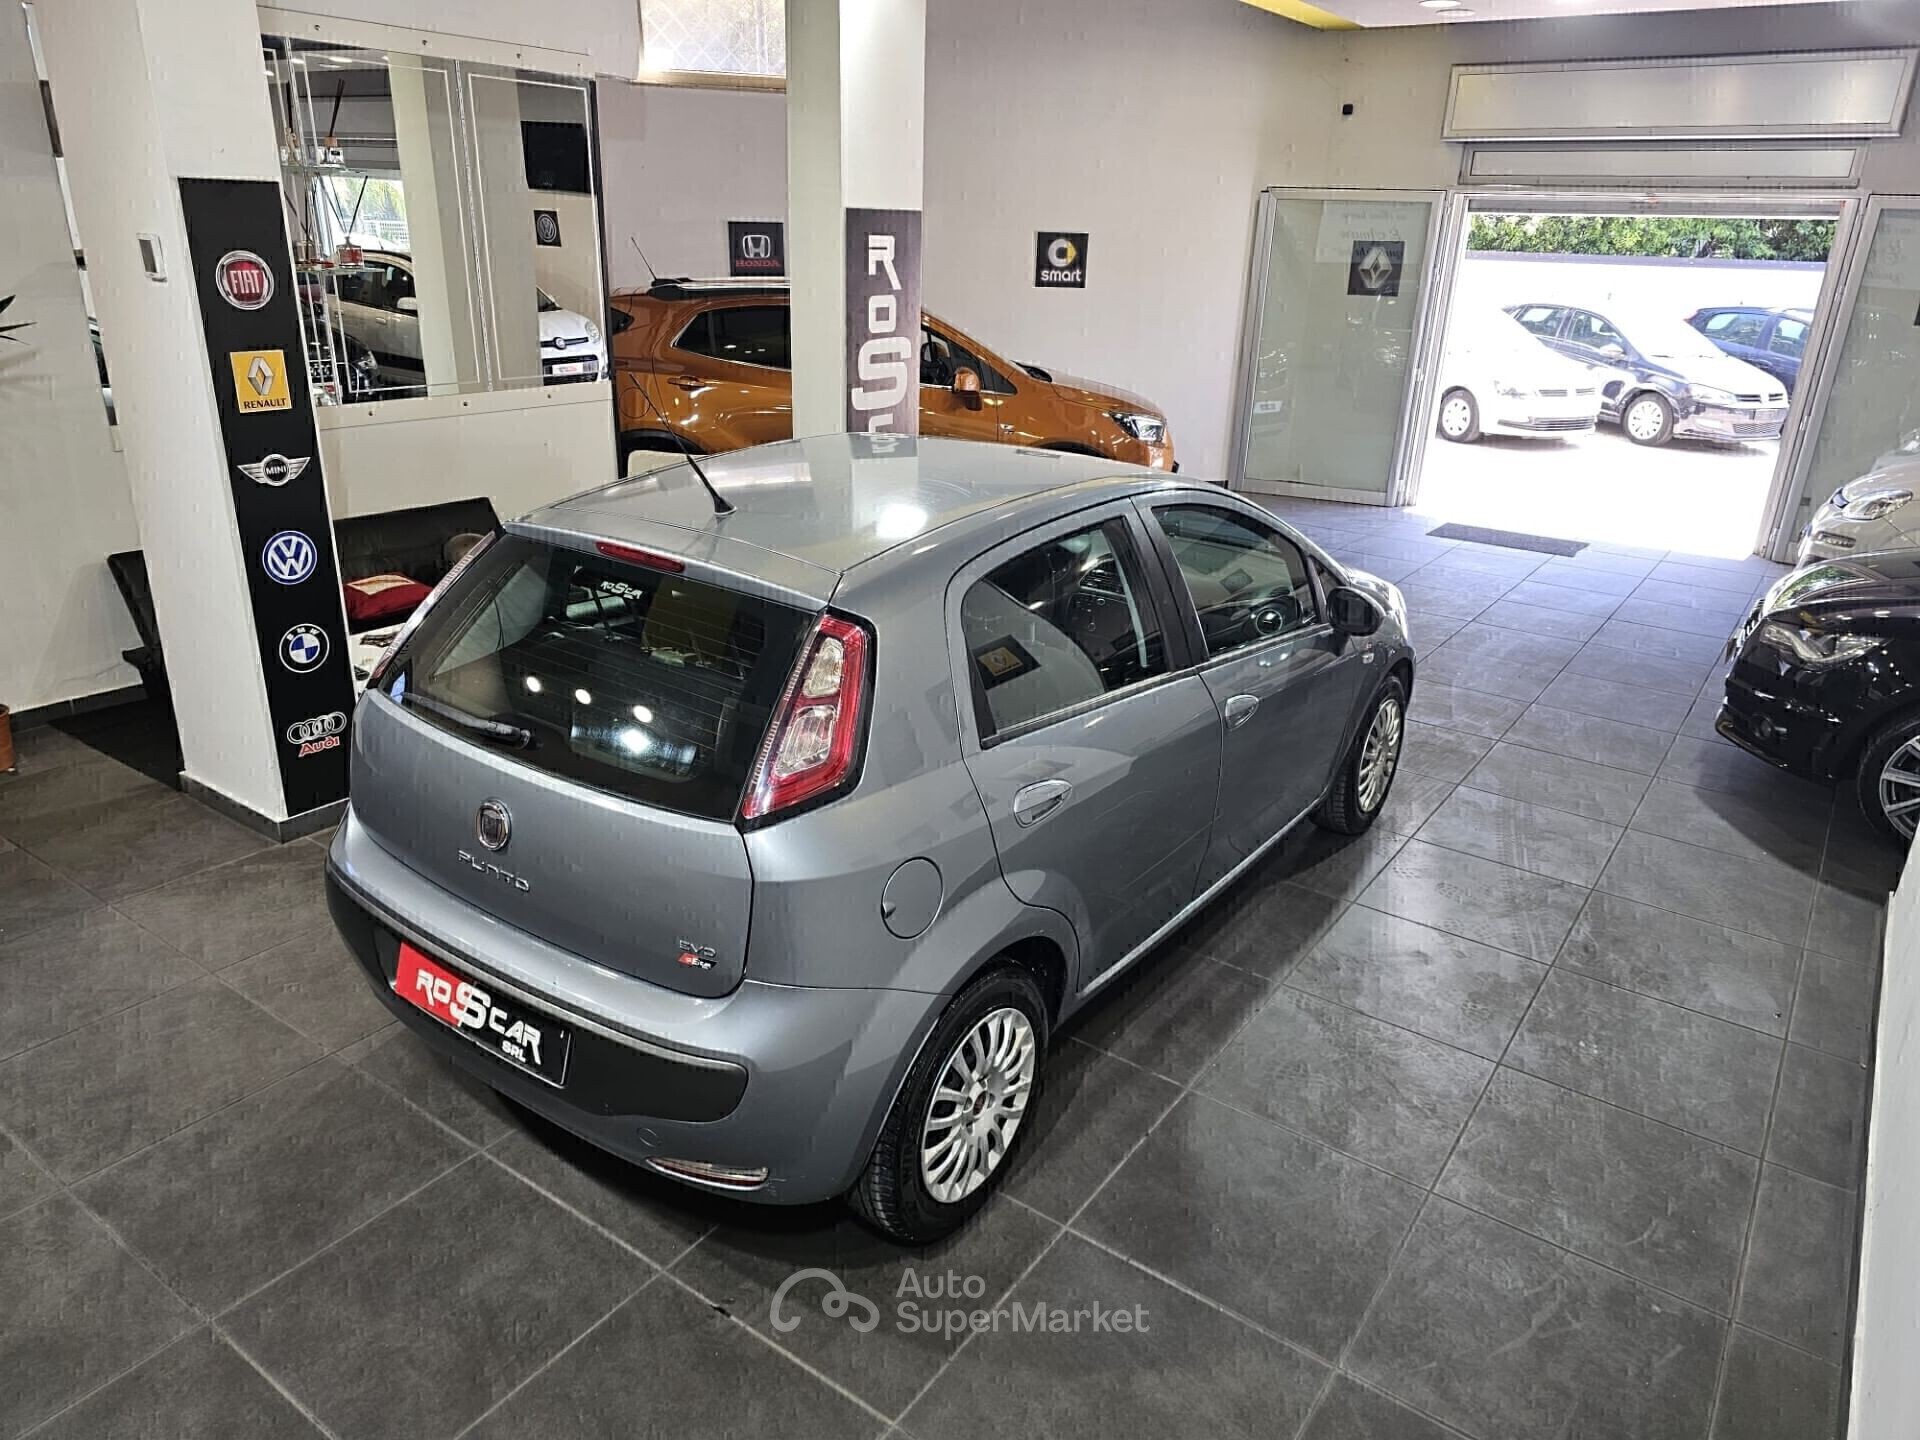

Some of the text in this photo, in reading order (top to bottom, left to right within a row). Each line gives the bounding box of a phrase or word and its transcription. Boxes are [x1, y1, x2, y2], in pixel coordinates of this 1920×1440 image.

[735, 259, 780, 267] HONDA
[229, 270, 261, 294] FIAT
[1040, 269, 1081, 281] smart
[243, 397, 287, 409] RENAULT
[265, 466, 287, 475] MINI
[298, 736, 341, 757] Audi
[458, 849, 530, 892] PUNTO
[679, 939, 716, 957] EVO
[502, 1040, 527, 1063] SRL
